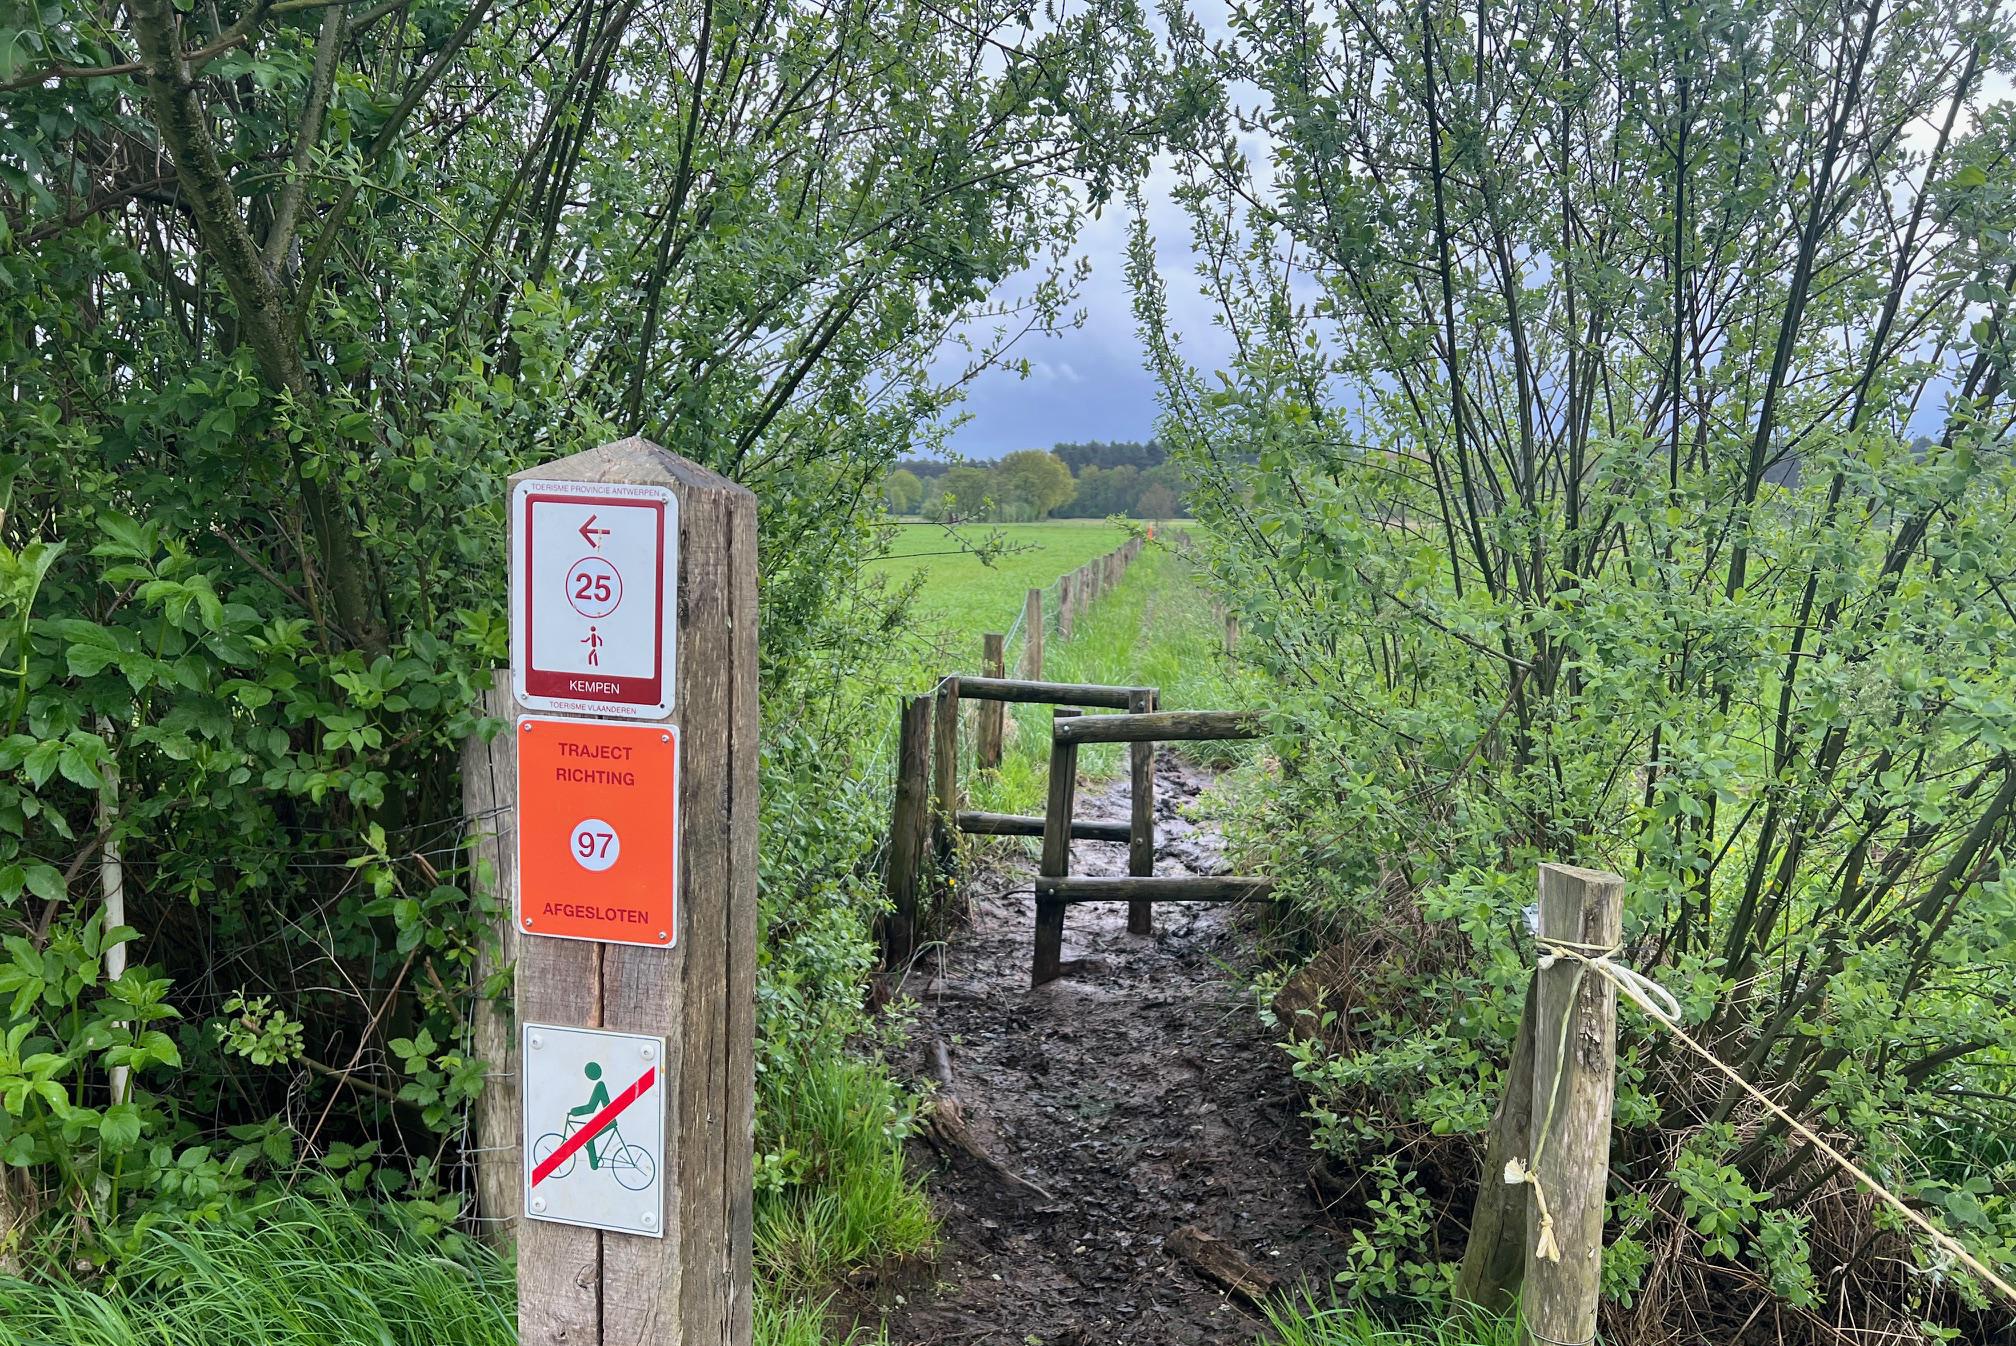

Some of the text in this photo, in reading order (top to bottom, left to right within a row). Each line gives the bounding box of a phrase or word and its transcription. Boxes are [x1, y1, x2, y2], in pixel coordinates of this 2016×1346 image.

[532, 483, 660, 497] TOERISME PROVINCIE ANTWERPEN
[575, 572, 611, 602] 25
[569, 680, 620, 694] KEMPEN
[549, 701, 637, 715] TOERISME VLAANDEREN
[558, 742, 632, 760] TRAJECT
[556, 767, 635, 786] RICHTING
[578, 831, 613, 858] 97
[543, 902, 649, 924] AFGESLOTEN
